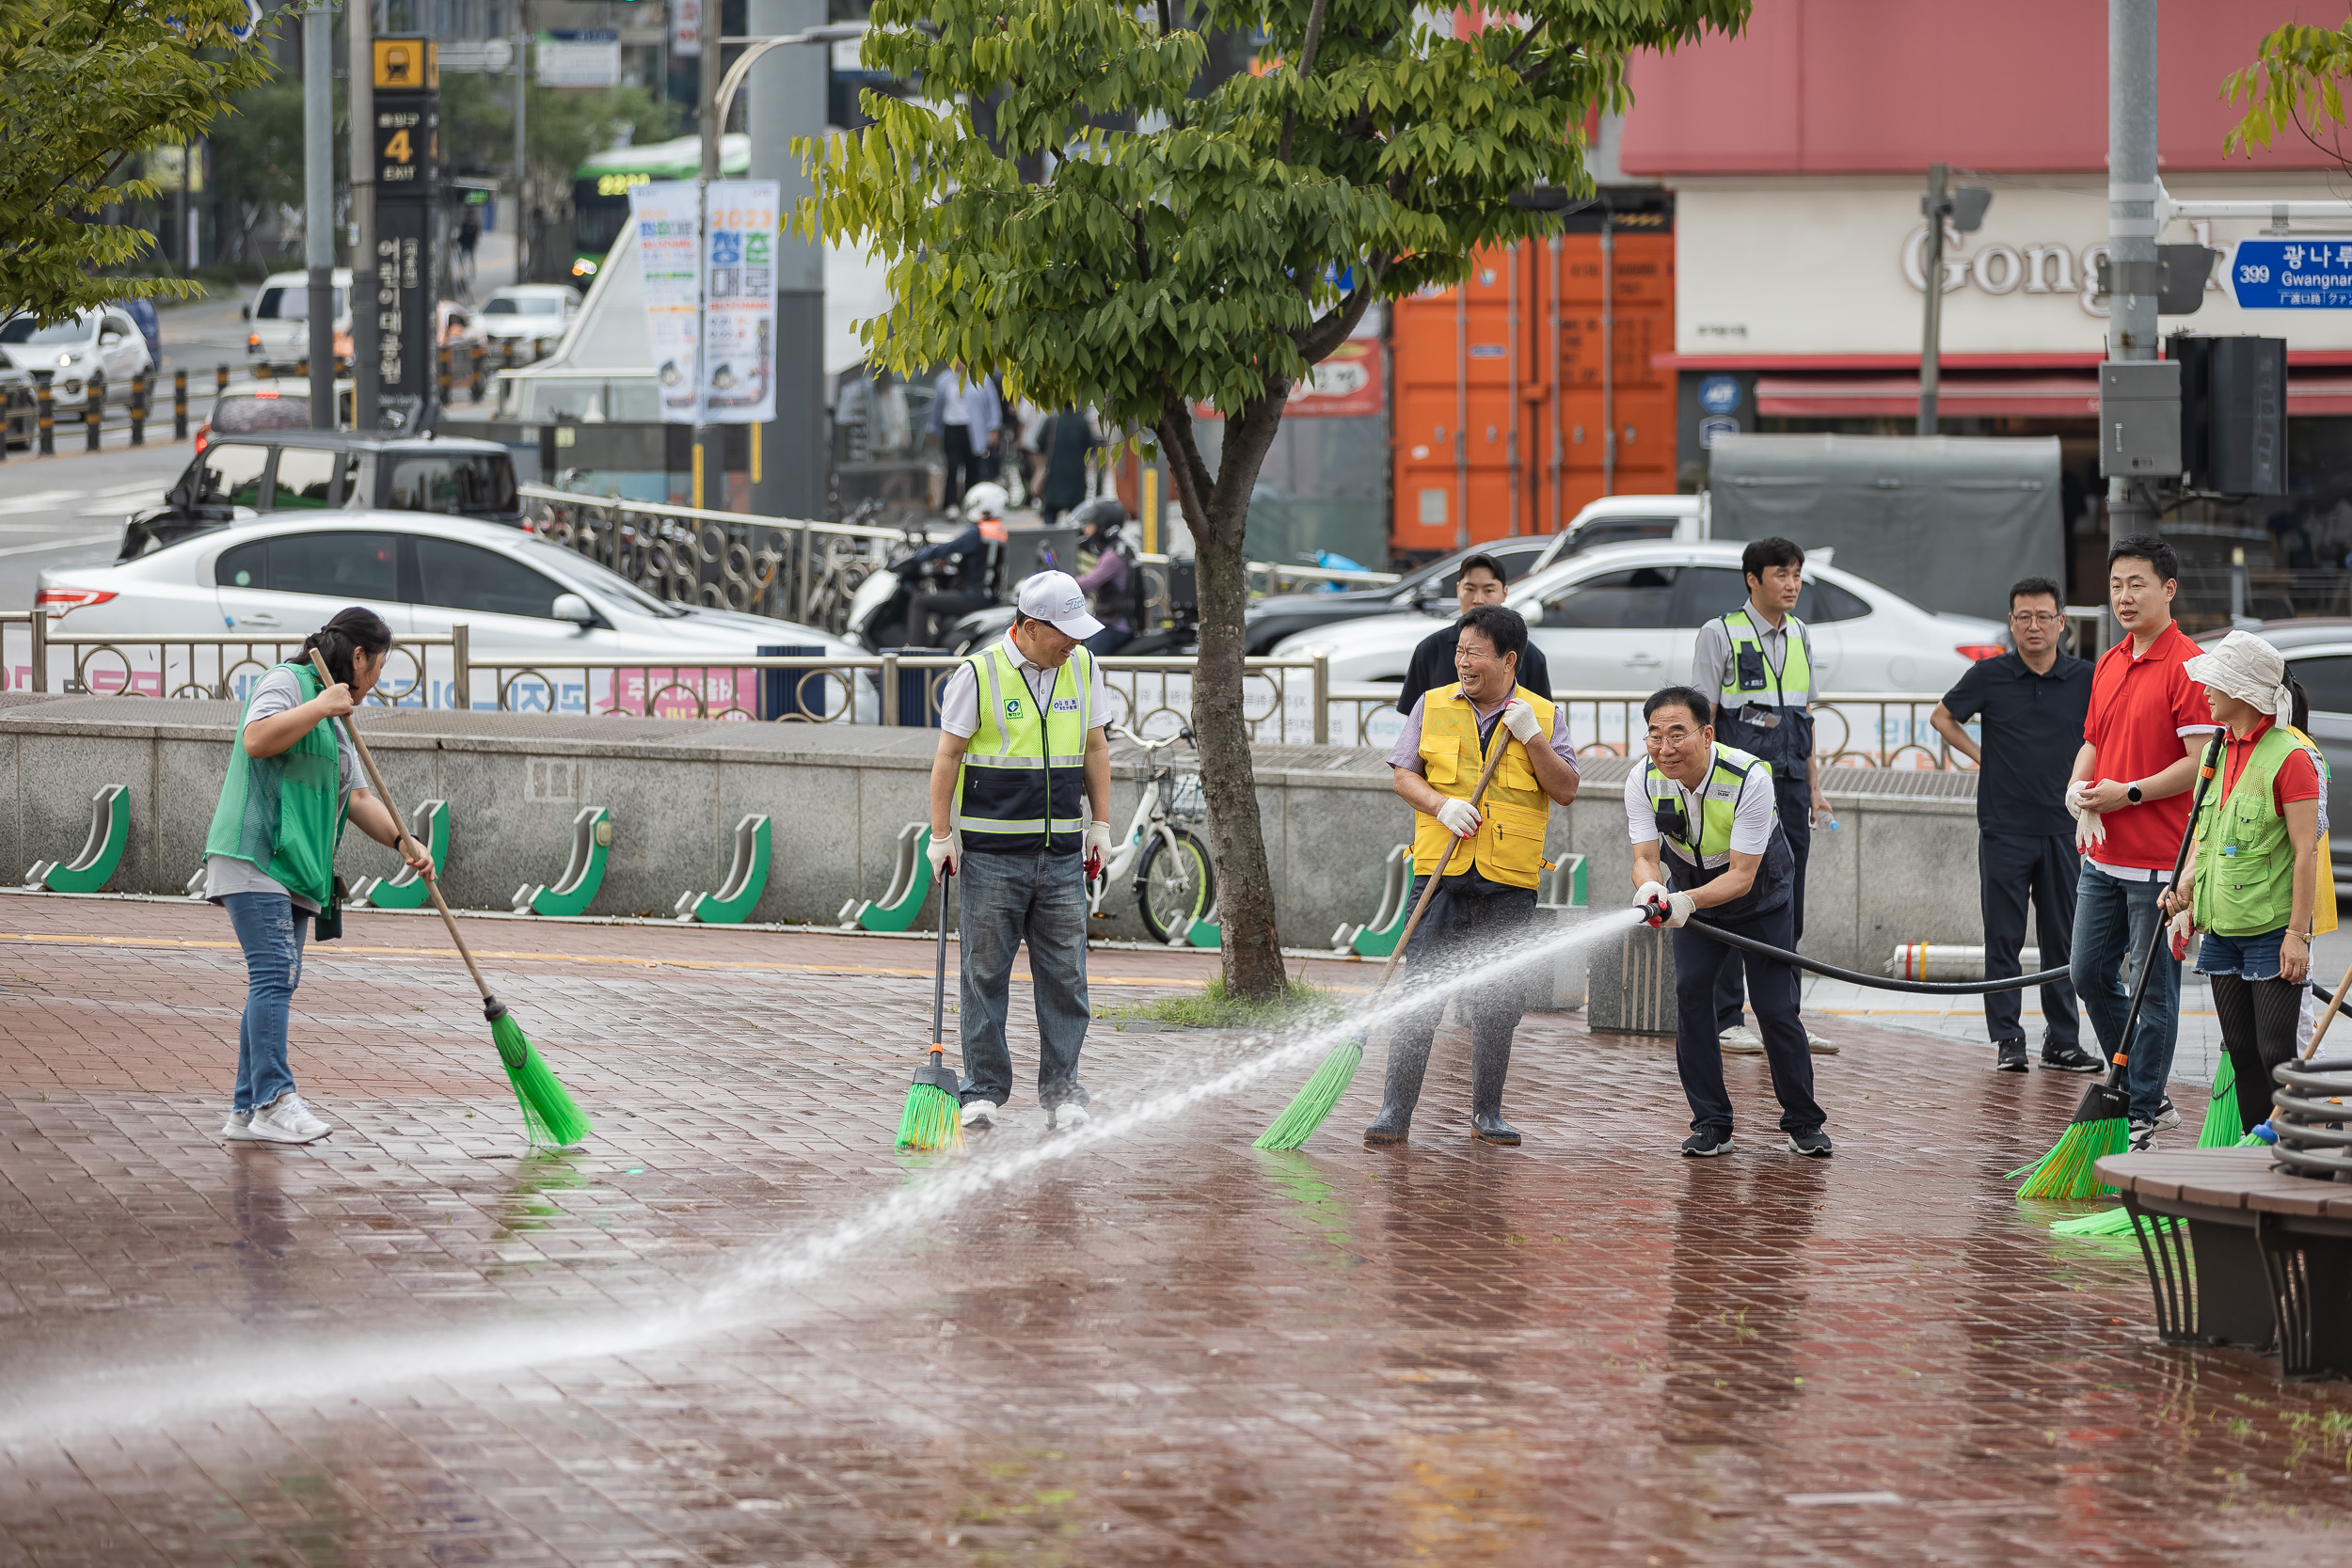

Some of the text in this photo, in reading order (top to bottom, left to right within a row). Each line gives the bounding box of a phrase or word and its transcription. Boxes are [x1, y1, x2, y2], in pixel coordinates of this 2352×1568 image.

[384, 129, 414, 164] 4
[383, 166, 416, 181] EXIT
[712, 209, 771, 228] 2023
[712, 231, 770, 262] 청춘
[711, 267, 770, 297] 대로
[2239, 264, 2270, 283] 399
[378, 237, 402, 384] 어린이대공원
